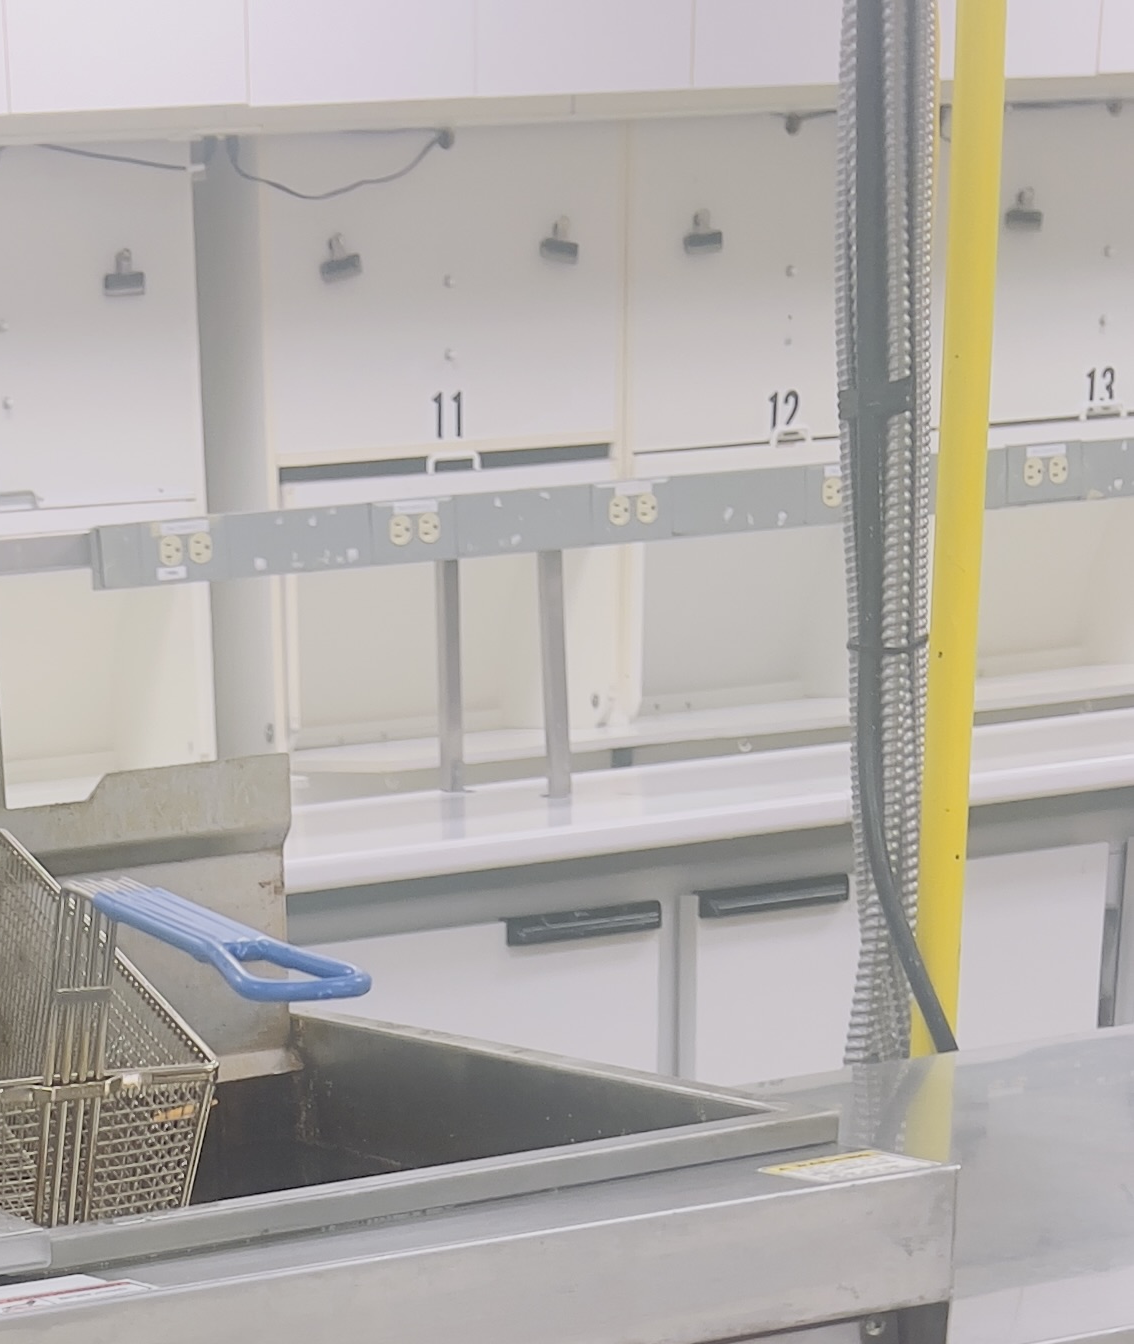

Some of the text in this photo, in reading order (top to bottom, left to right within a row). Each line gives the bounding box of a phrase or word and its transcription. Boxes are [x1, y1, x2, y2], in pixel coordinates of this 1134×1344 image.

[1087, 367, 1115, 401] 13
[432, 390, 463, 439] 11
[769, 390, 799, 429] 12
